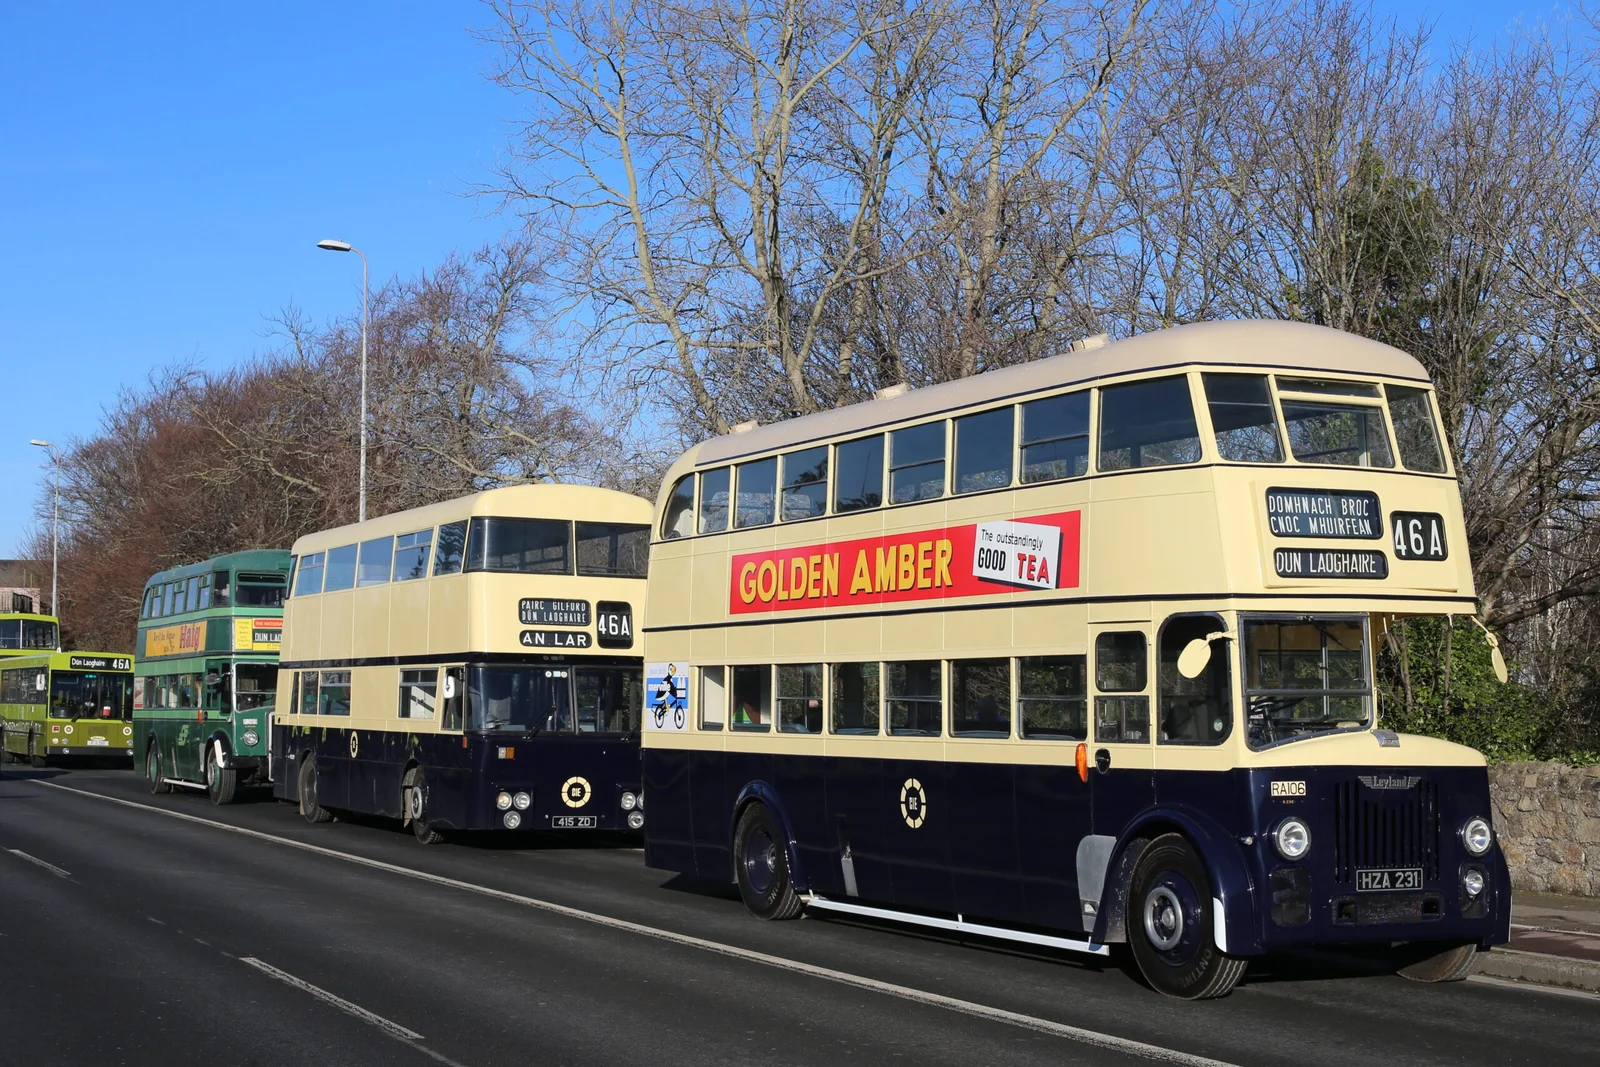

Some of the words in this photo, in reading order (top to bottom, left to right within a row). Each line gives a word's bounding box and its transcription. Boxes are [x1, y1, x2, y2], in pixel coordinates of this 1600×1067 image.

[1269, 495, 1332, 515] DOMHNACH
[1341, 498, 1370, 517] BROC
[1270, 516, 1301, 533] CNOC
[1309, 516, 1373, 536] MHUIRFEAN
[980, 528, 993, 542] The
[995, 531, 1043, 550] outstandingly
[1394, 518, 1443, 556] 46A
[739, 553, 840, 604] GOLDEN
[849, 539, 954, 595] AMBER
[977, 547, 1006, 572] GOOD
[1017, 552, 1050, 584] TEA
[1276, 552, 1302, 573] DUN
[1309, 552, 1377, 574] LAOGHAIRE
[543, 611, 586, 624] LAOGHAIRE
[598, 614, 631, 636] 46A
[179, 625, 201, 651] Haig
[254, 632, 268, 642] DUN
[269, 633, 282, 642] LAO
[522, 632, 545, 645] AN
[554, 633, 587, 646] LAR
[83, 658, 106, 668] Laoghaire
[112, 658, 130, 670] 46A
[1373, 775, 1407, 789] Leyland
[558, 817, 574, 827] 415
[1362, 872, 1391, 889] HZA
[1395, 871, 1418, 888] 231
